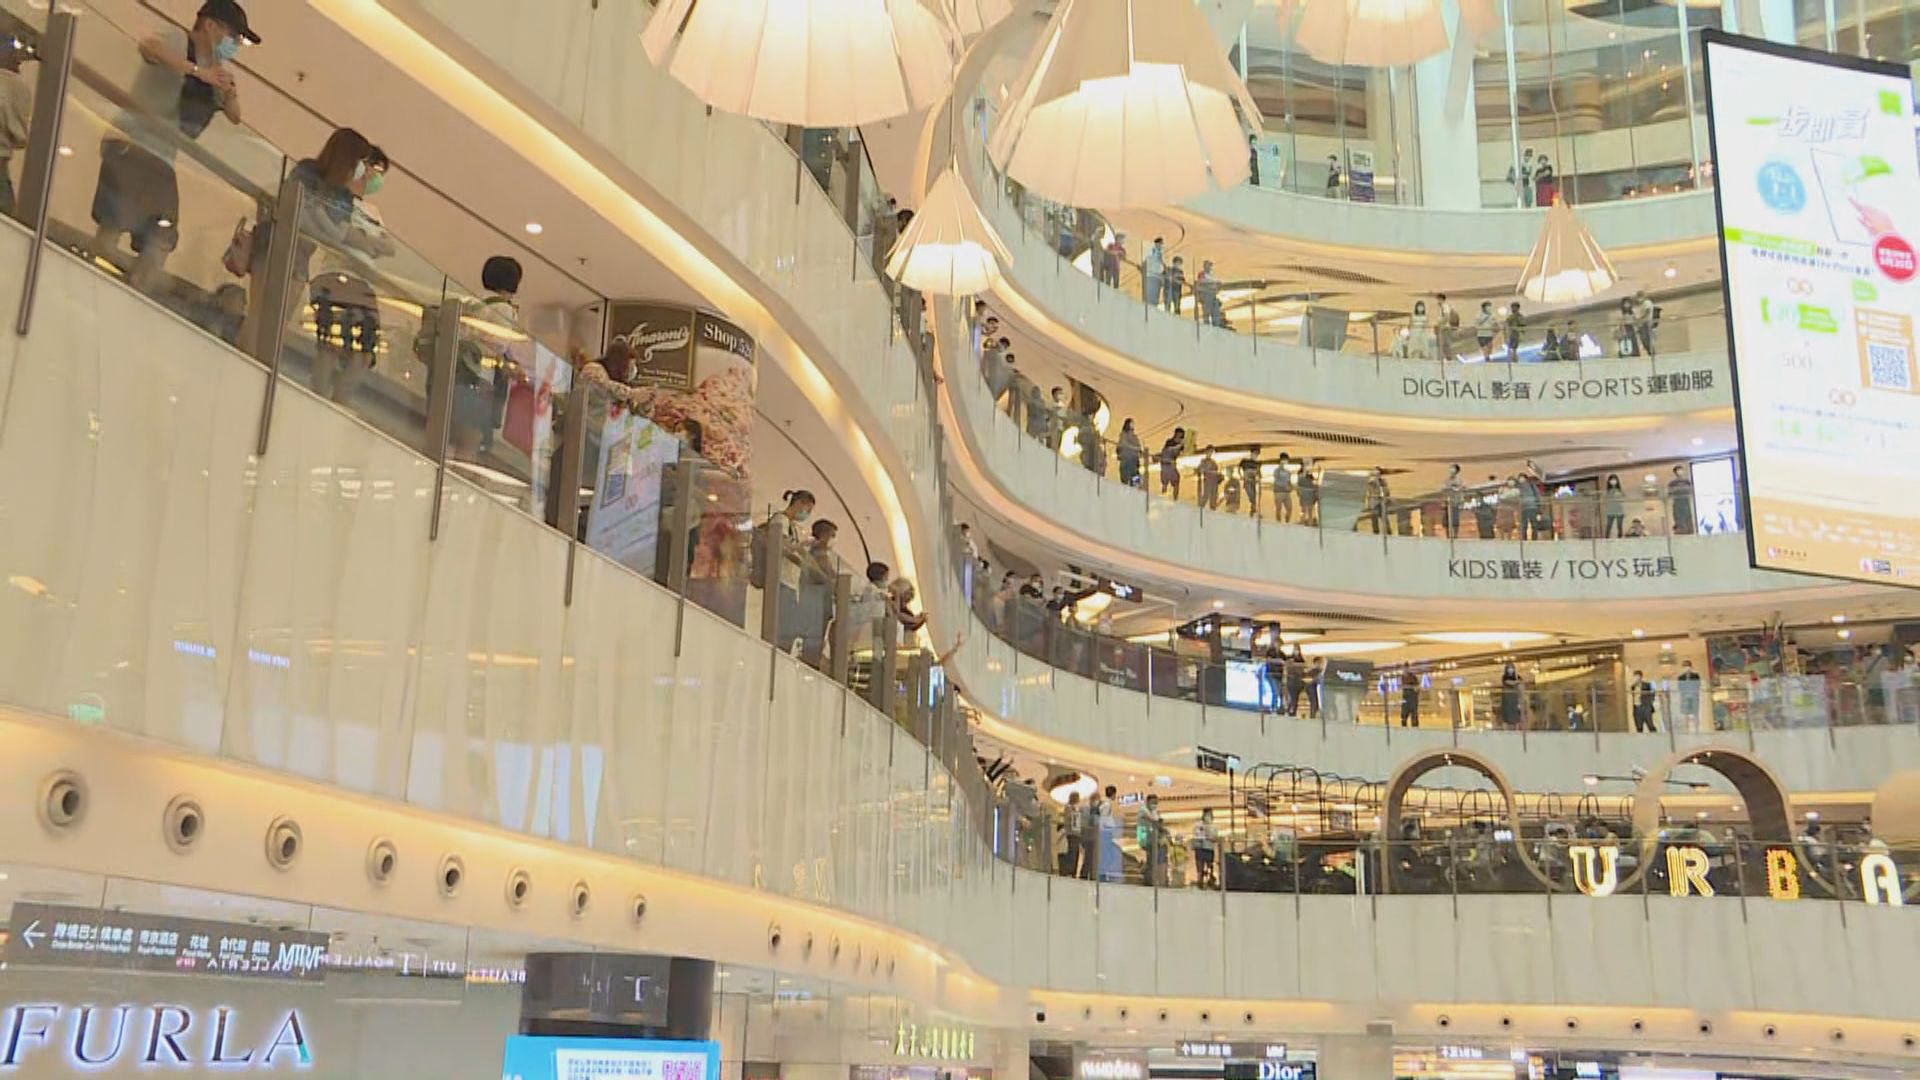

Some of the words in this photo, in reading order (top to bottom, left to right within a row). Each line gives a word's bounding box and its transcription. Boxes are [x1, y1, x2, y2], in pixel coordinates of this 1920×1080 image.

[704, 322, 737, 352] Shop
[1403, 378, 1487, 399] DIGITAL
[1491, 381, 1532, 400] 影音
[1554, 378, 1643, 399] SPORTS
[1646, 369, 1714, 395] 運動服
[1449, 560, 1498, 580] KIDS
[1502, 560, 1542, 579] 童裝
[1567, 559, 1628, 580] TOYS
[1632, 556, 1677, 578] 玩具
[1, 1005, 312, 1066] FURLA
[1259, 1062, 1302, 1080] Dior
